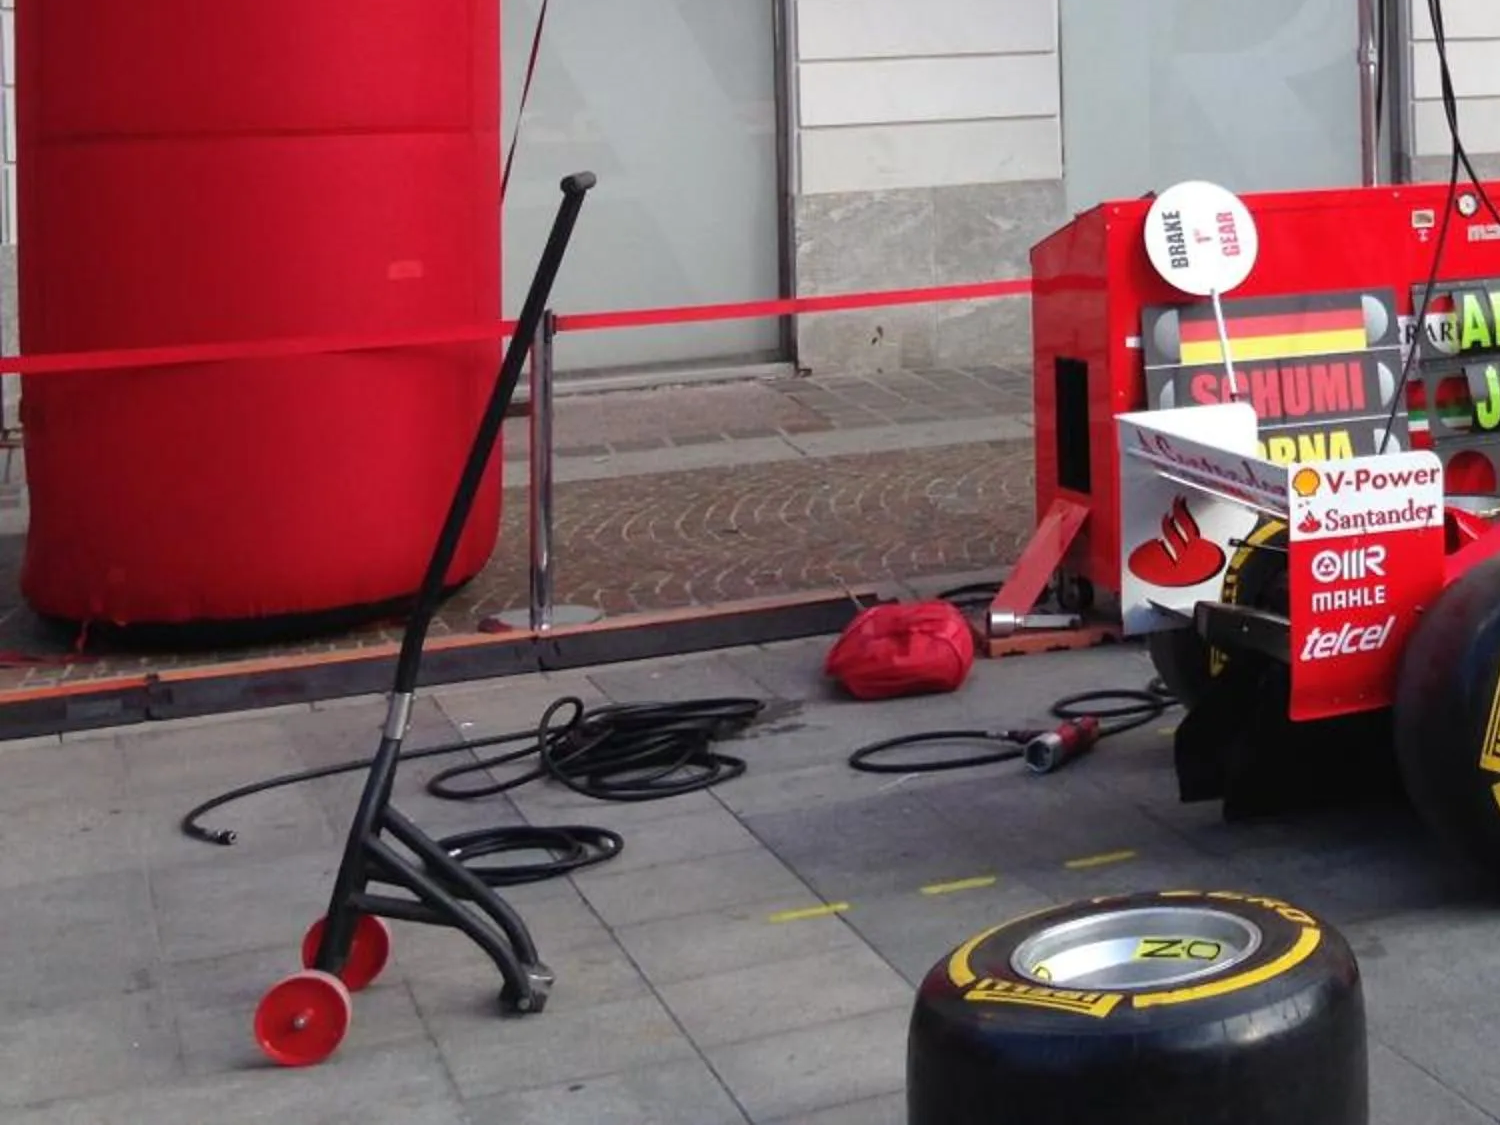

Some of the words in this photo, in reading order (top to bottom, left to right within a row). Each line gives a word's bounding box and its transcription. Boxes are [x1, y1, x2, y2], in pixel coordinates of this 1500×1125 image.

[1161, 210, 1189, 269] BRAKE
[1215, 211, 1240, 257] GEAR
[1325, 466, 1440, 494] V-Power
[1325, 498, 1437, 532] Santander
[1312, 584, 1386, 612] MAHLE
[1300, 614, 1397, 661] telcel
